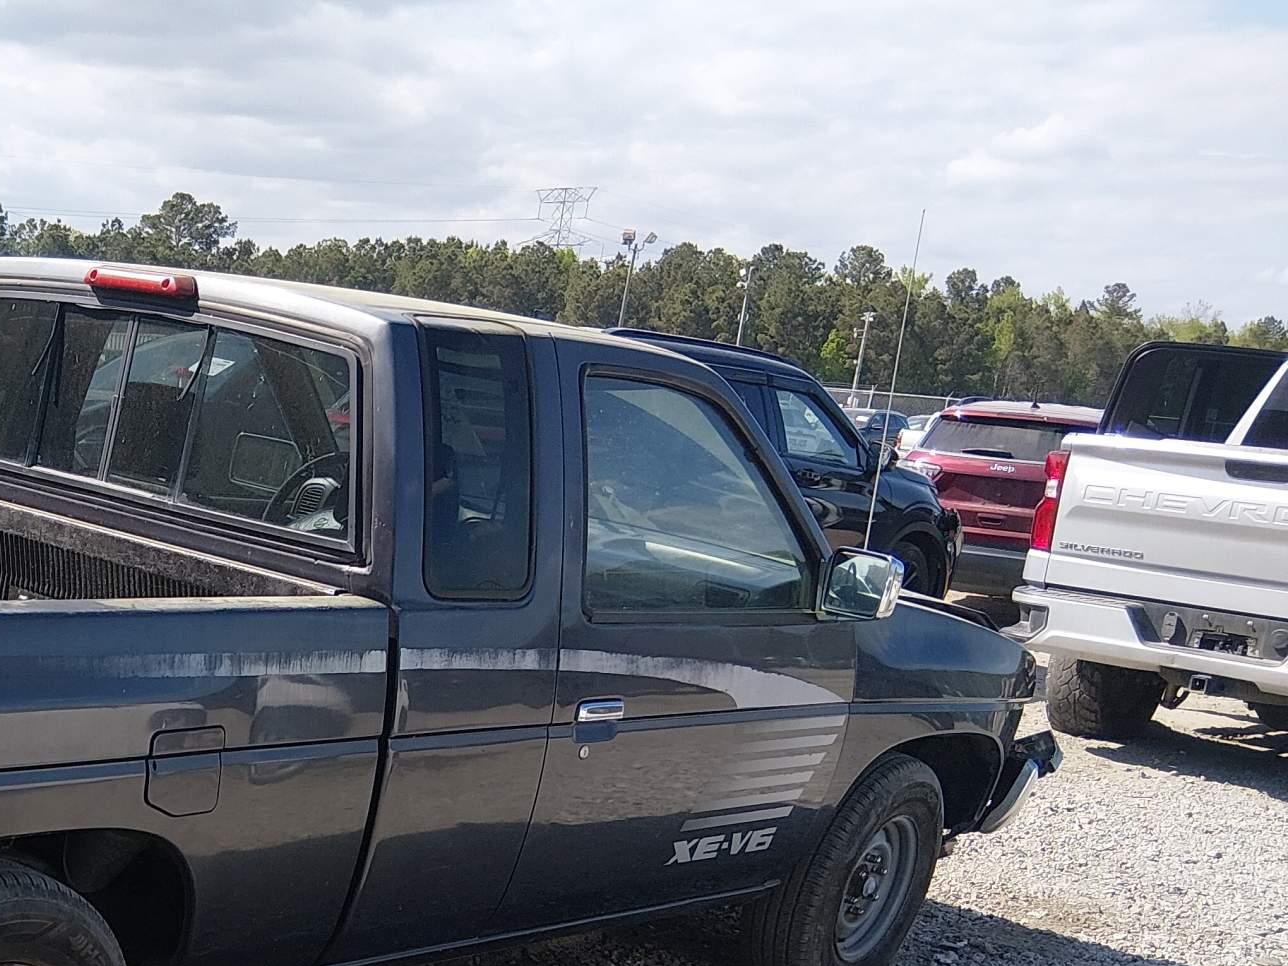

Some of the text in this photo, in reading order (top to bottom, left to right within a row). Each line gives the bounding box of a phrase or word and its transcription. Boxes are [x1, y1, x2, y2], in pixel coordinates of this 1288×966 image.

[989, 463, 1016, 474] Jeep
[1059, 541, 1144, 560] SILVERADO
[663, 826, 778, 866] XE-V6
